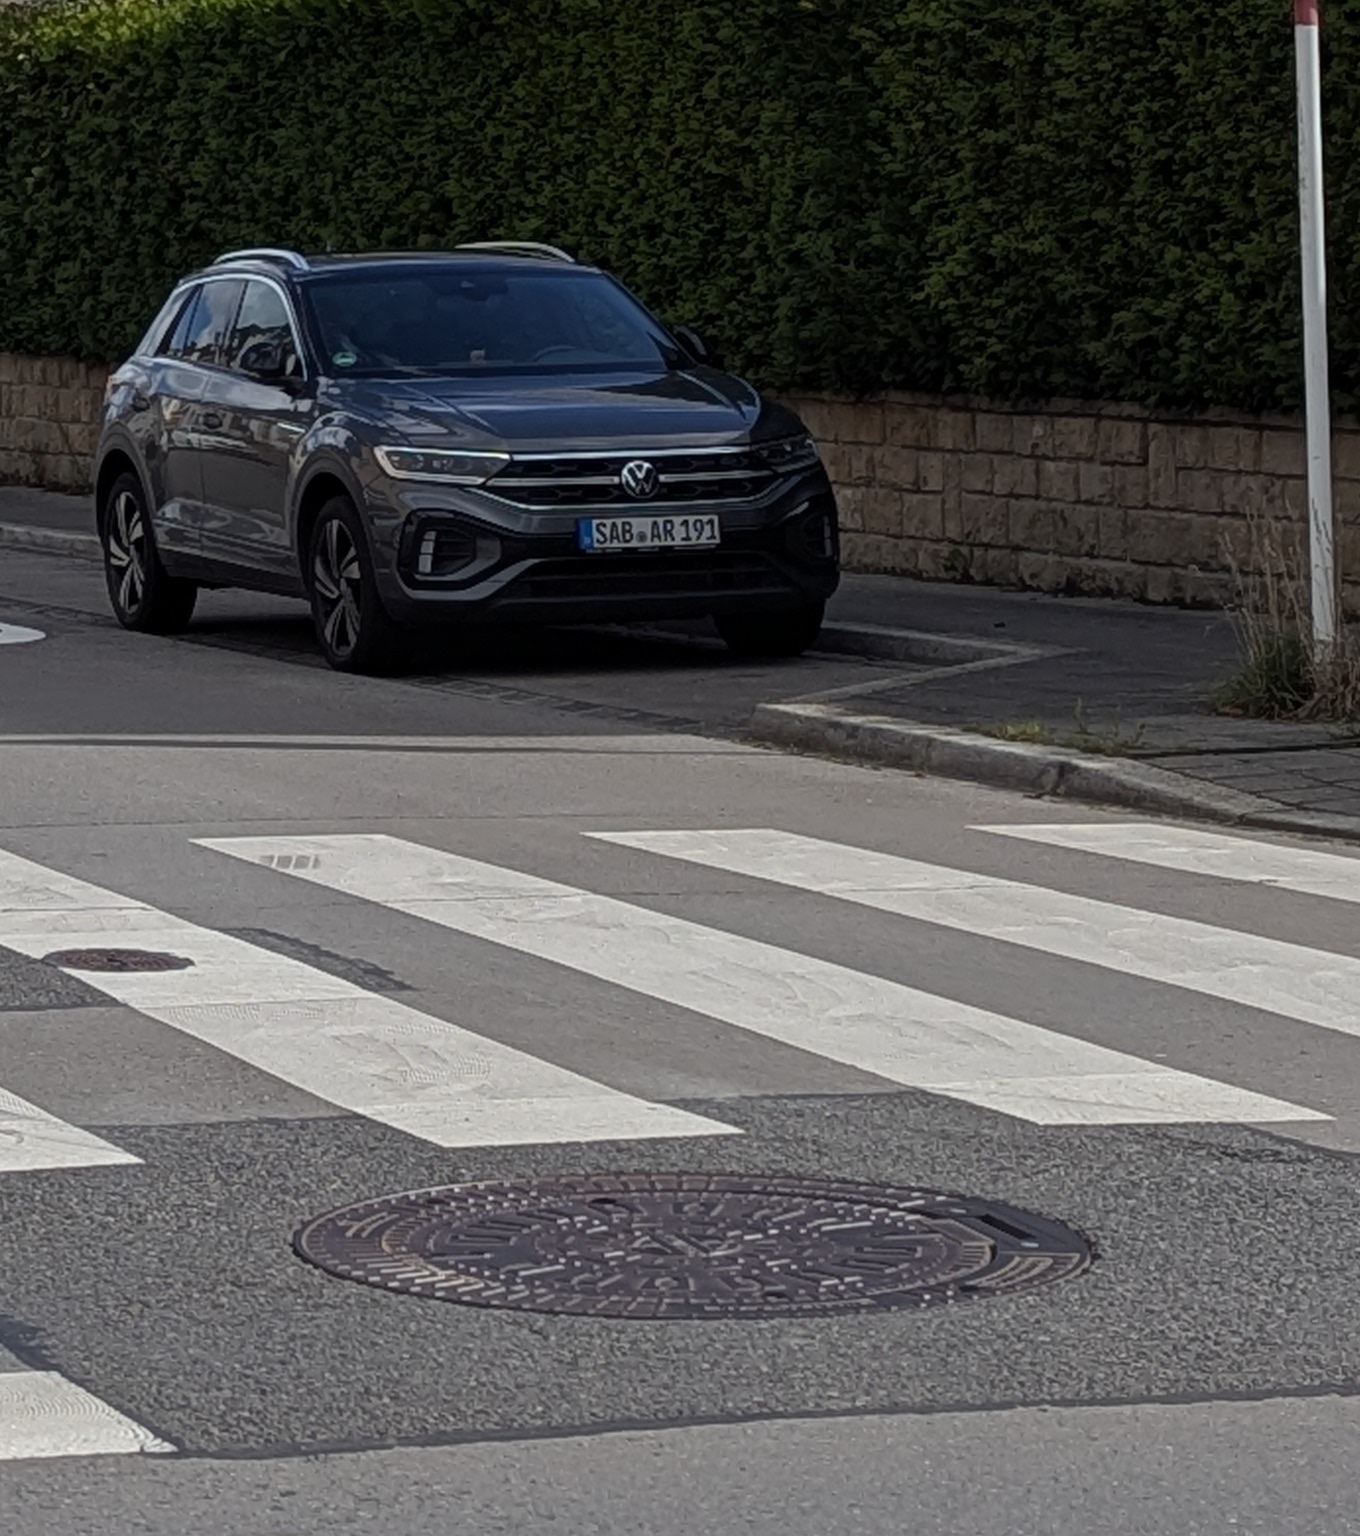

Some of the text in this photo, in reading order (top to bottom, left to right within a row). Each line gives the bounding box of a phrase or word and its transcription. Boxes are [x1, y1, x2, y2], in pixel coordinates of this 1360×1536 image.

[594, 521, 634, 545] SAB
[649, 519, 676, 543] AR
[680, 517, 717, 543] 191
